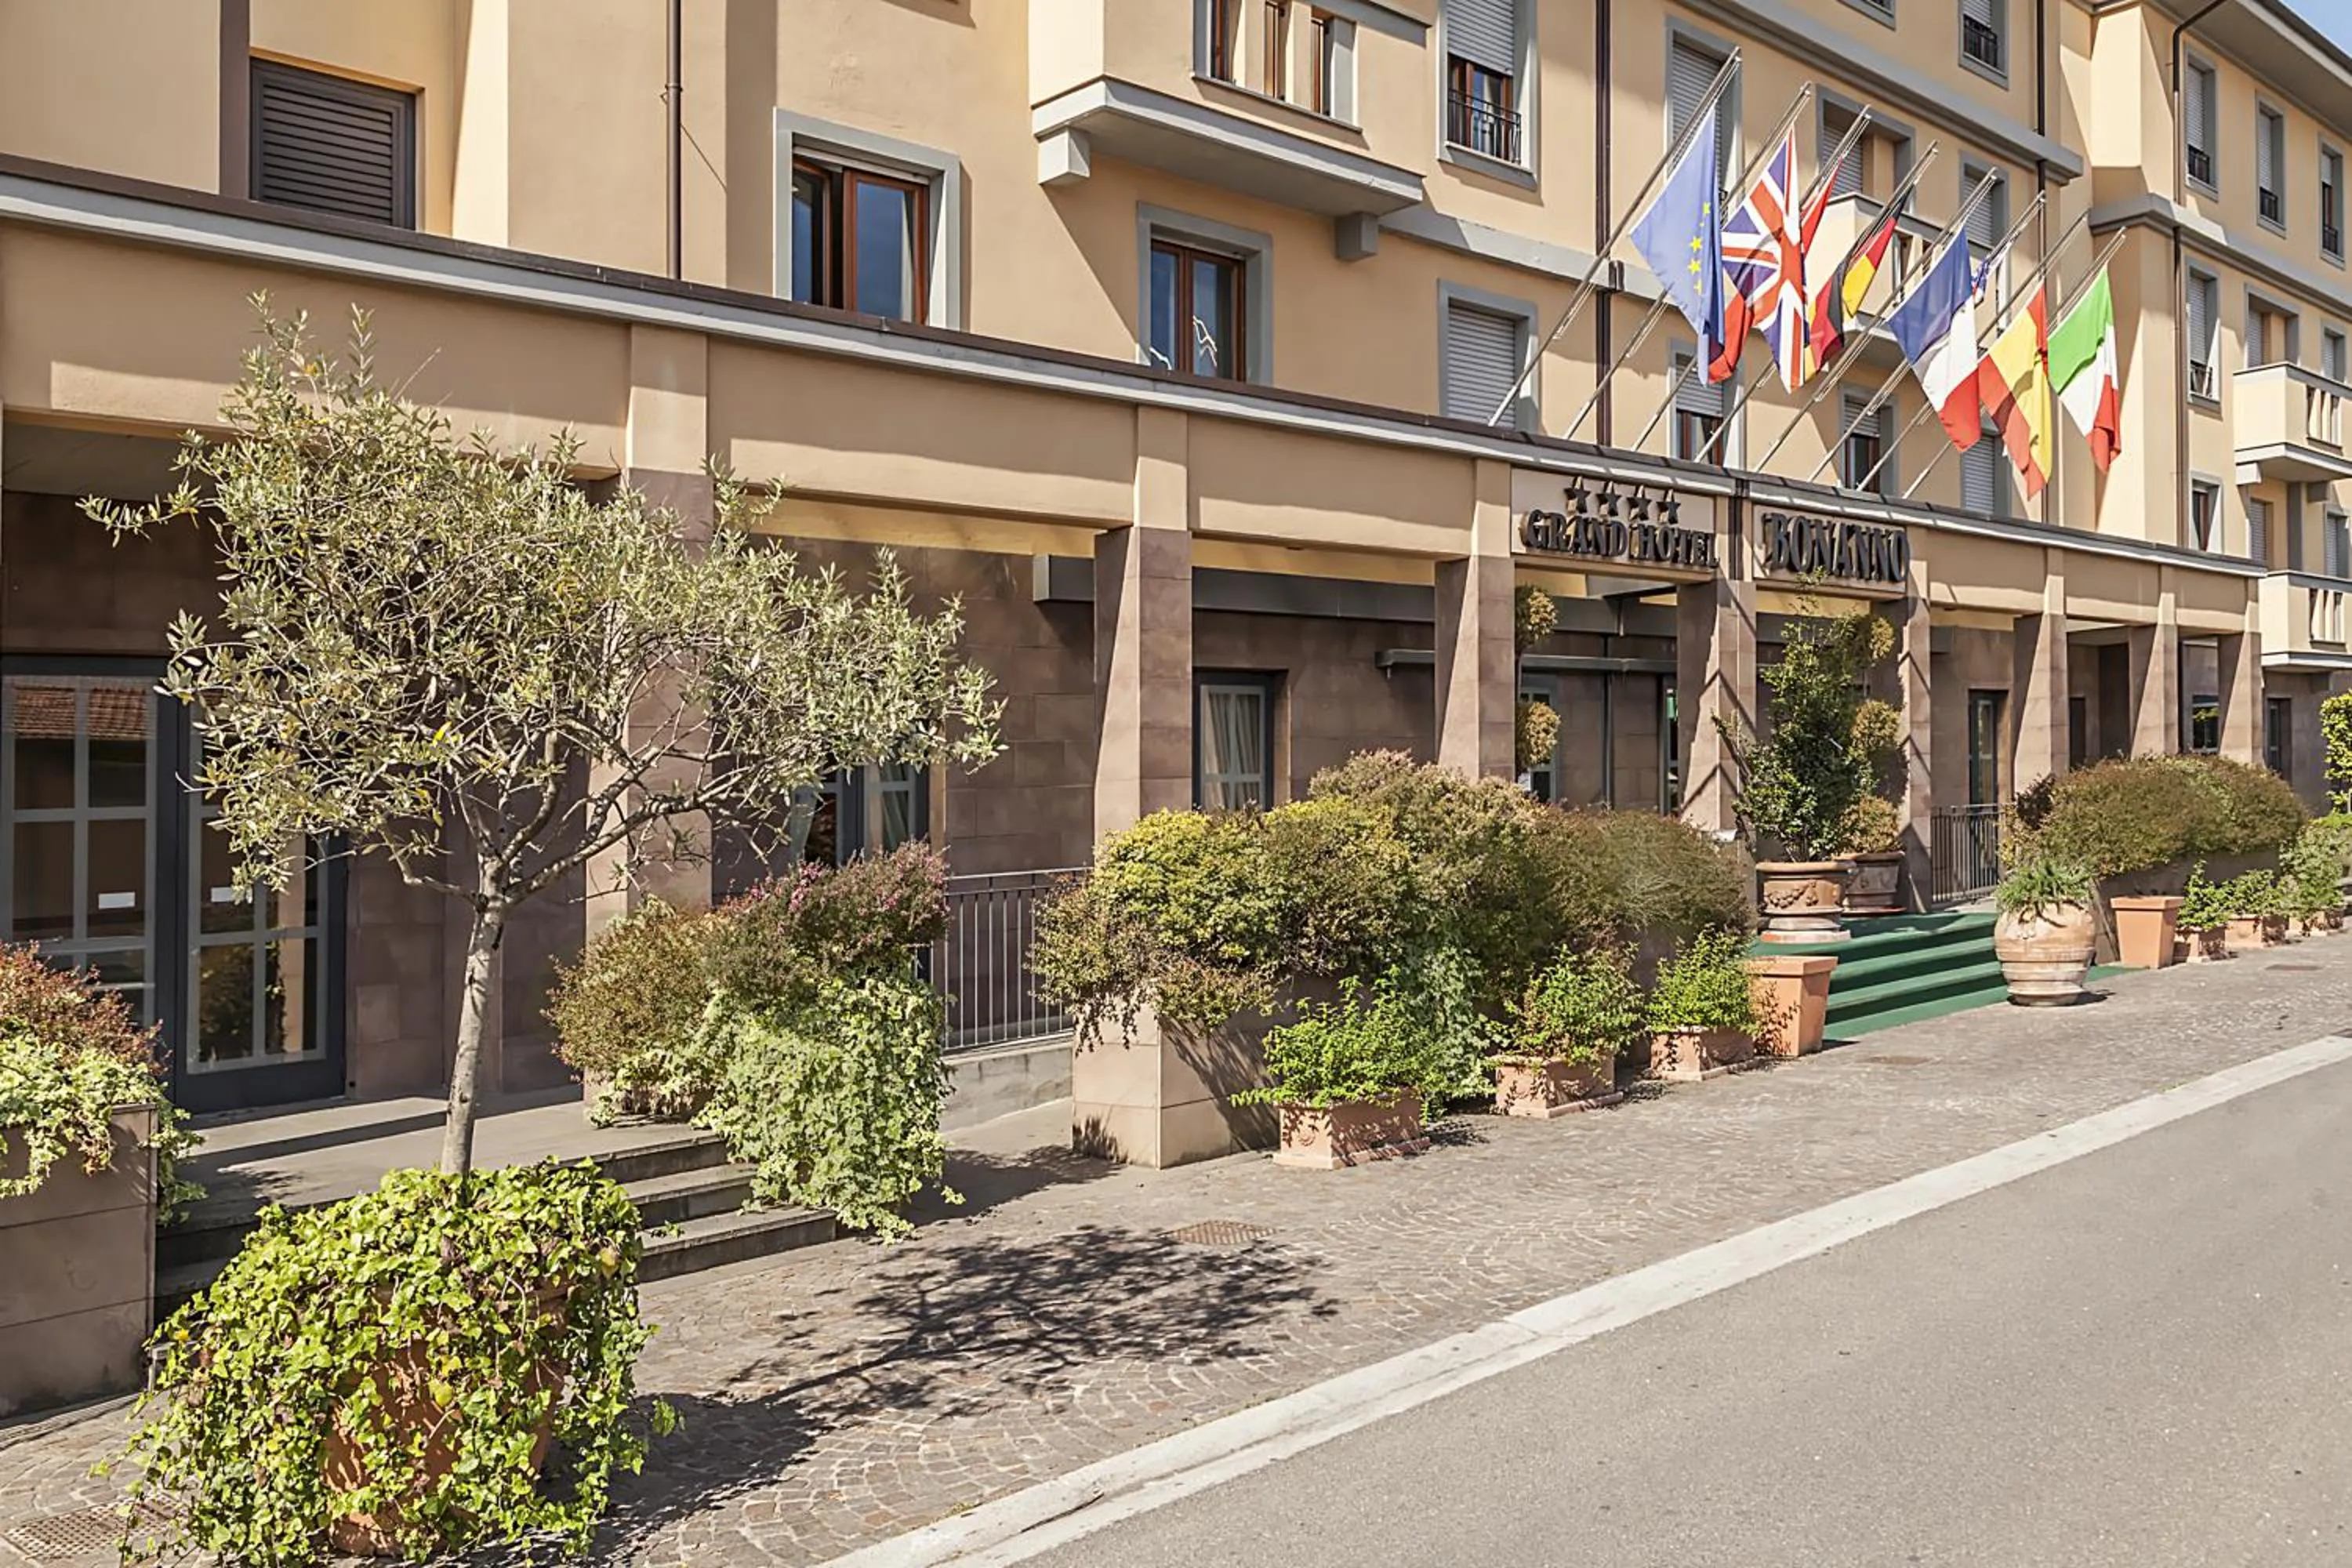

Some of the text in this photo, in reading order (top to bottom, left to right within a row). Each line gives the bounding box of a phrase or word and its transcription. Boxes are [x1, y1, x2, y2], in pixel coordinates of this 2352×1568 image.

[1523, 510, 1720, 568] GRAND HOTEL
[1763, 513, 1910, 583] BONANNO
